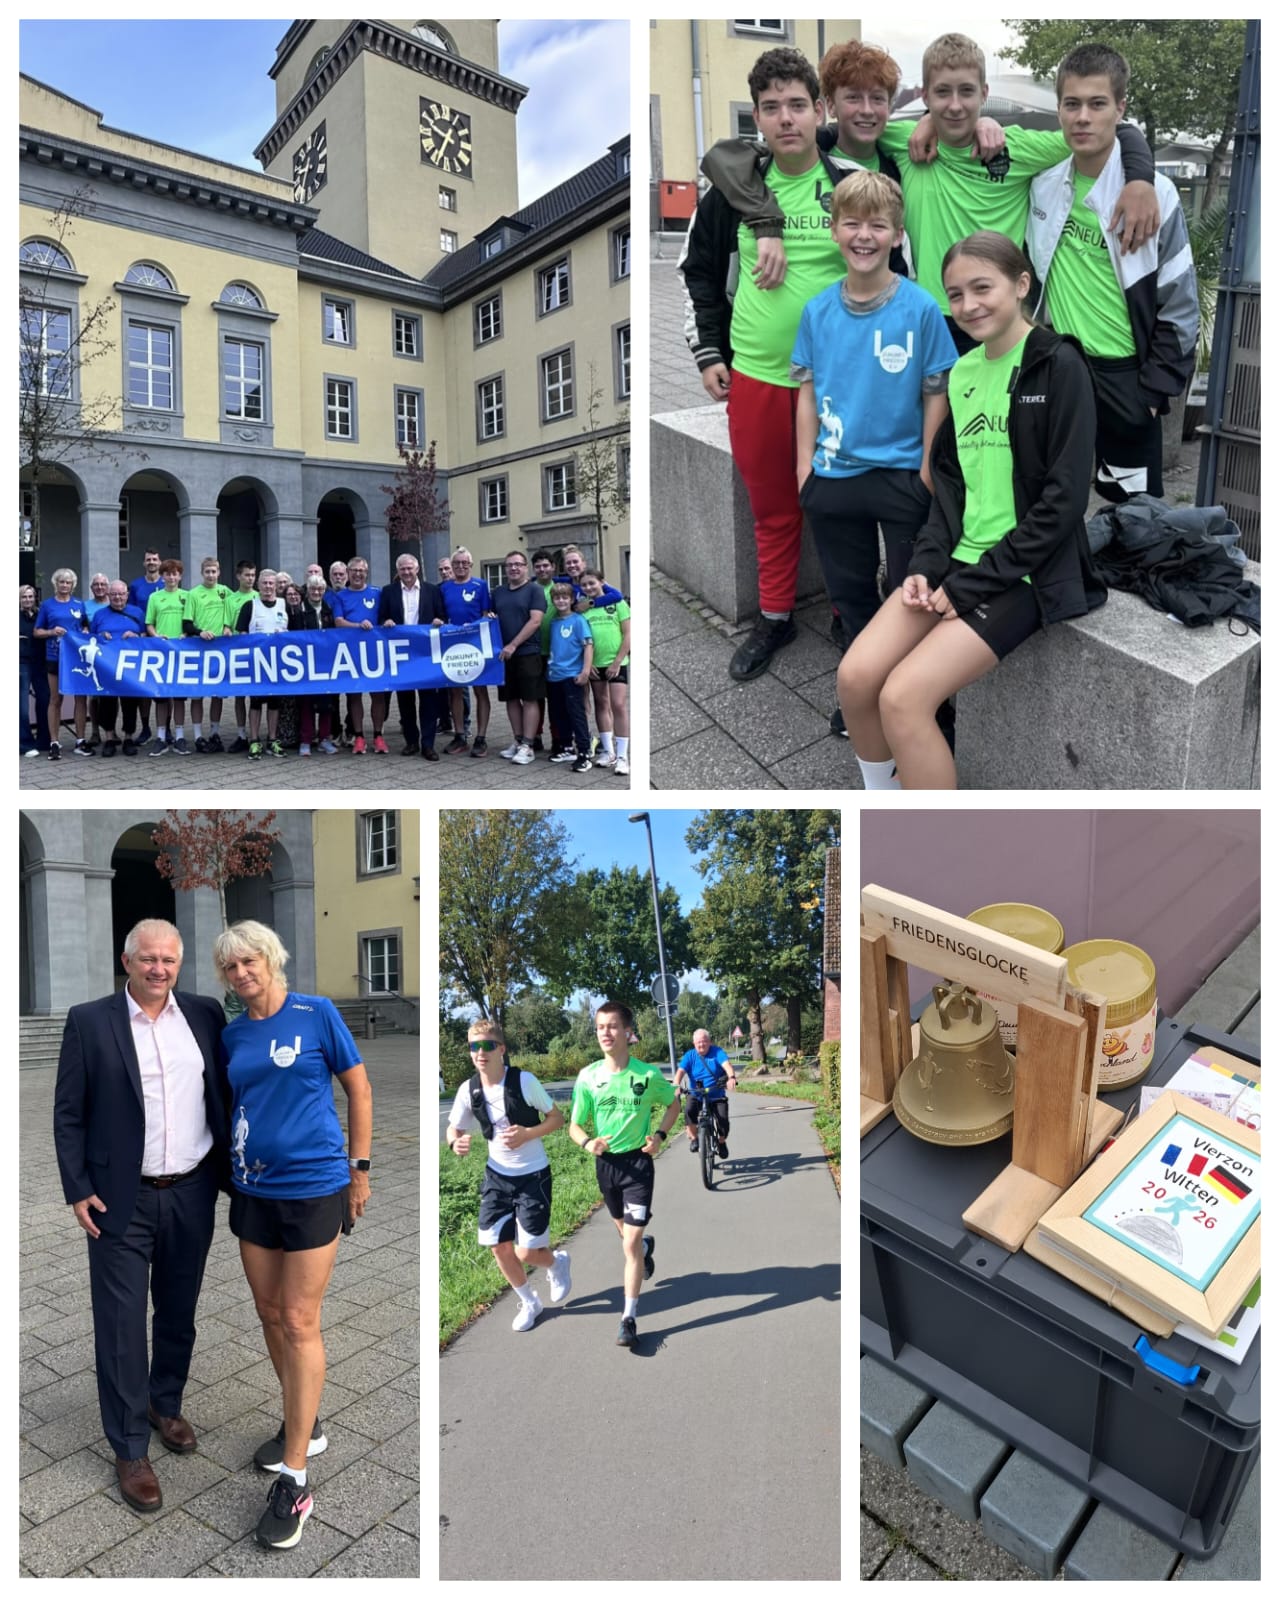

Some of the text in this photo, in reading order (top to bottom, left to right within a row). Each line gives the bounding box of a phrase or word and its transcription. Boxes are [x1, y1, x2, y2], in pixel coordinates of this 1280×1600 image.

[115, 638, 410, 685] FRIEDENSLAUF
[445, 652, 479, 661] ZUKUNFT
[447, 661, 479, 669] FRIEDEN
[892, 916, 1028, 982] FRIEDENSGLOCKE
[1141, 1181, 1218, 1229] 20 26
